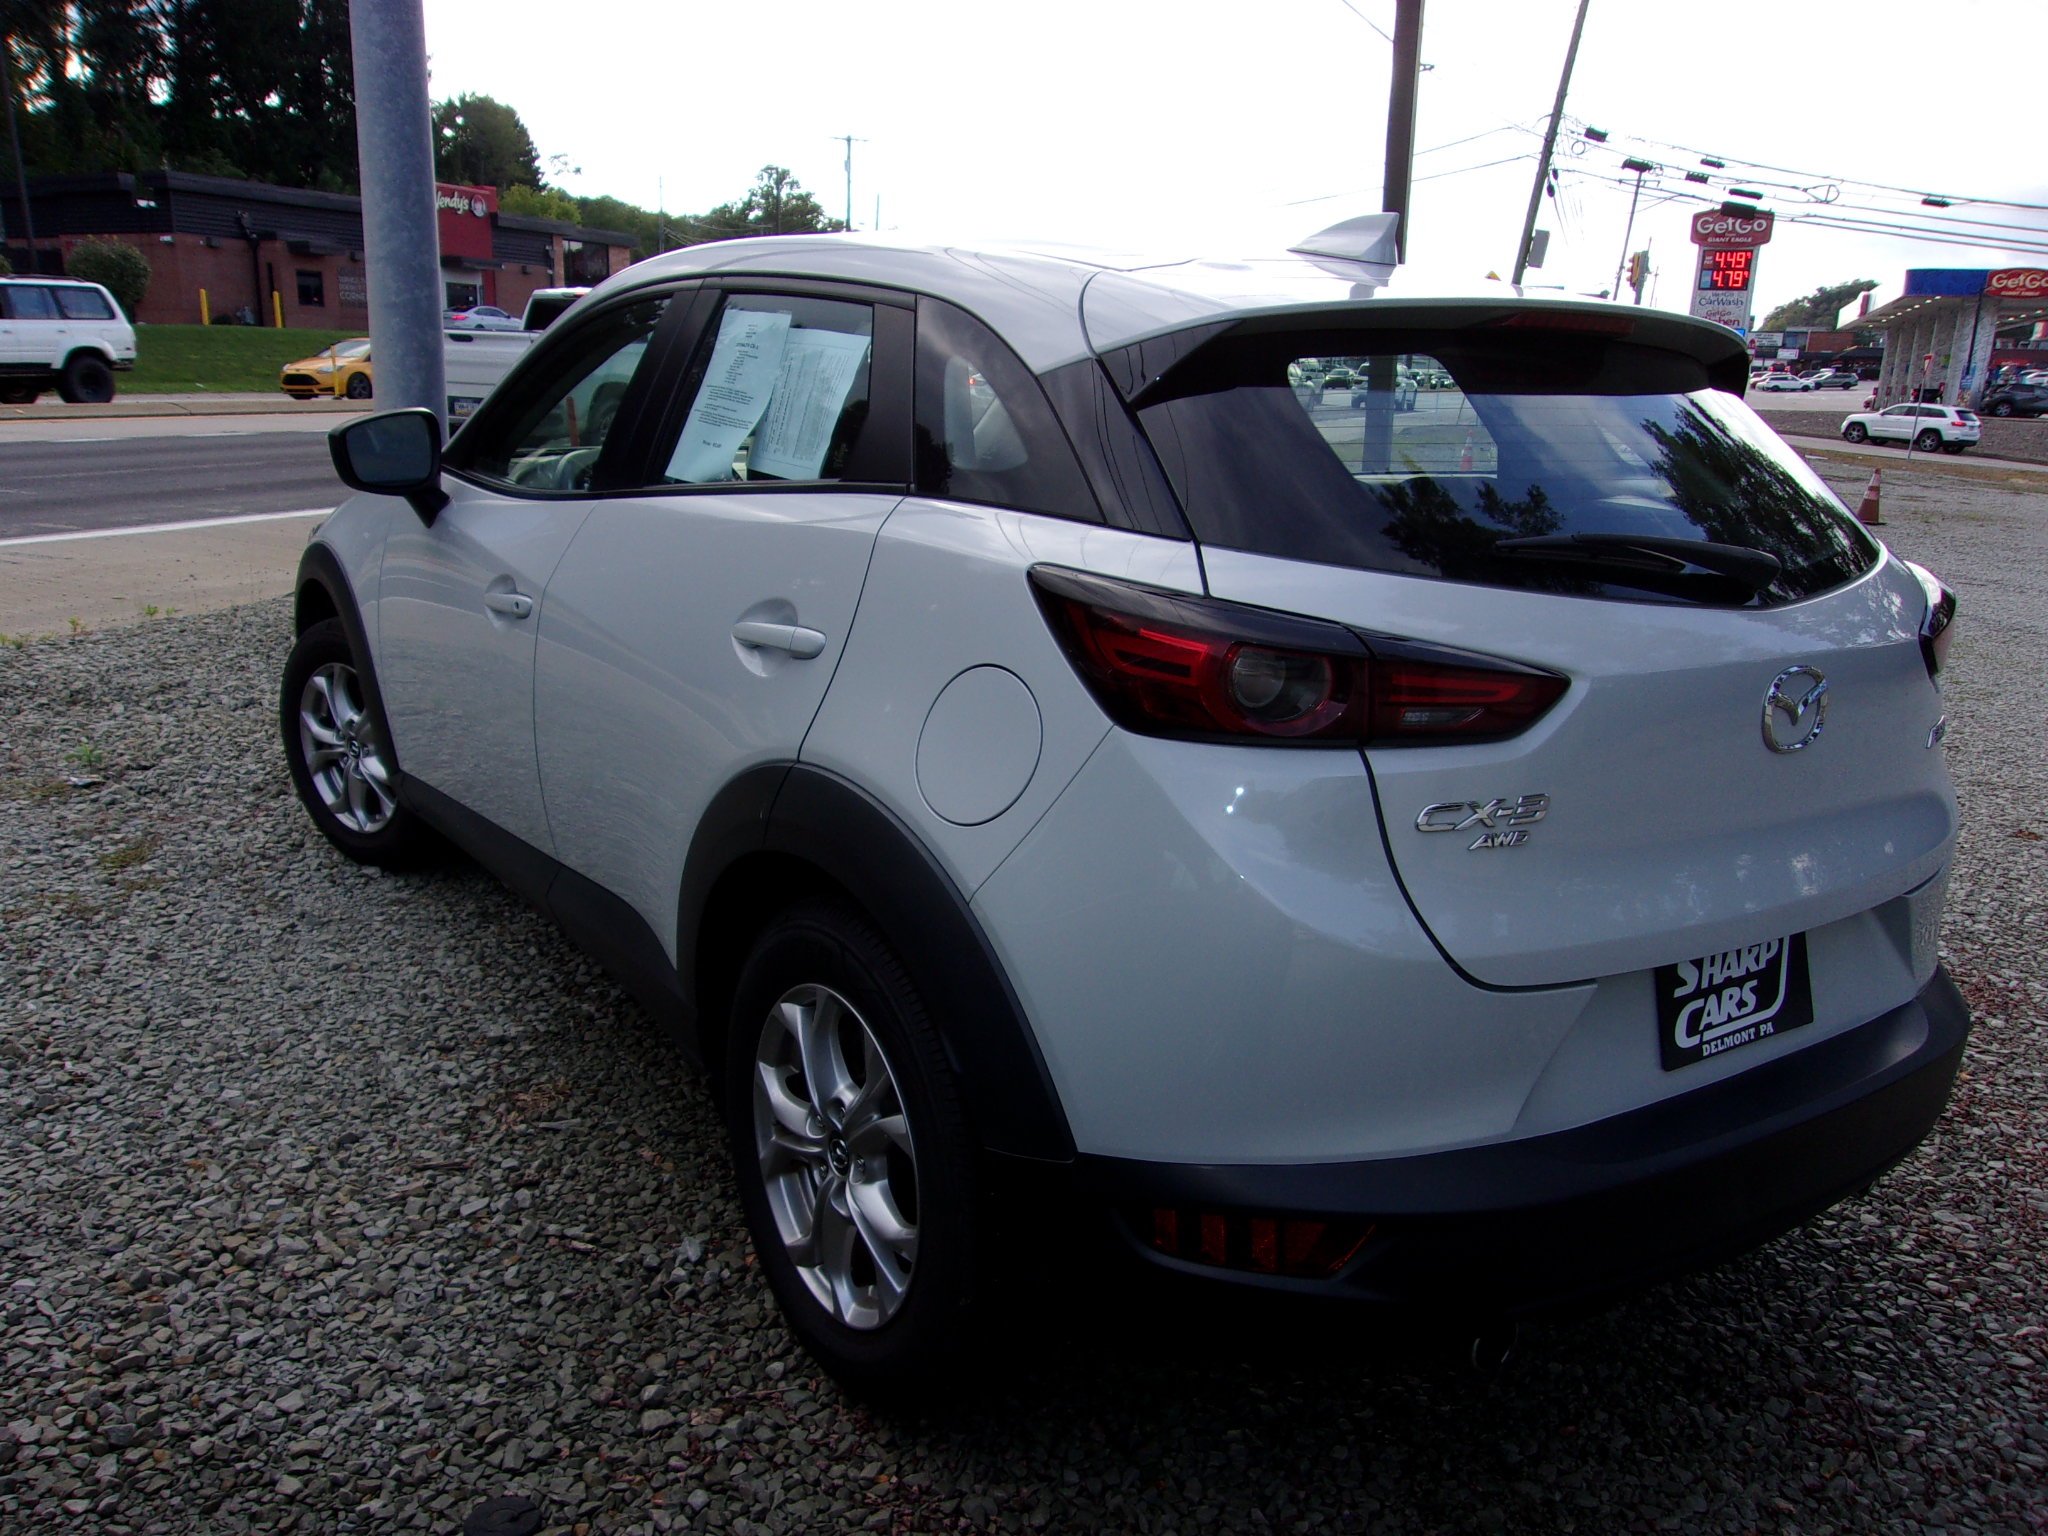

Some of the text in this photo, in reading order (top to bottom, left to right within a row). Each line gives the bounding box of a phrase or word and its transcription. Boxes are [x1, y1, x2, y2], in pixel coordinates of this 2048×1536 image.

[1696, 216, 1767, 234] GetGo
[1415, 793, 1550, 832] CX-3
[1467, 829, 1531, 851] AWD
[1673, 939, 1780, 999] SHARP
[1674, 979, 1759, 1049] CARS
[1702, 1021, 1775, 1057] DELMONT PA
